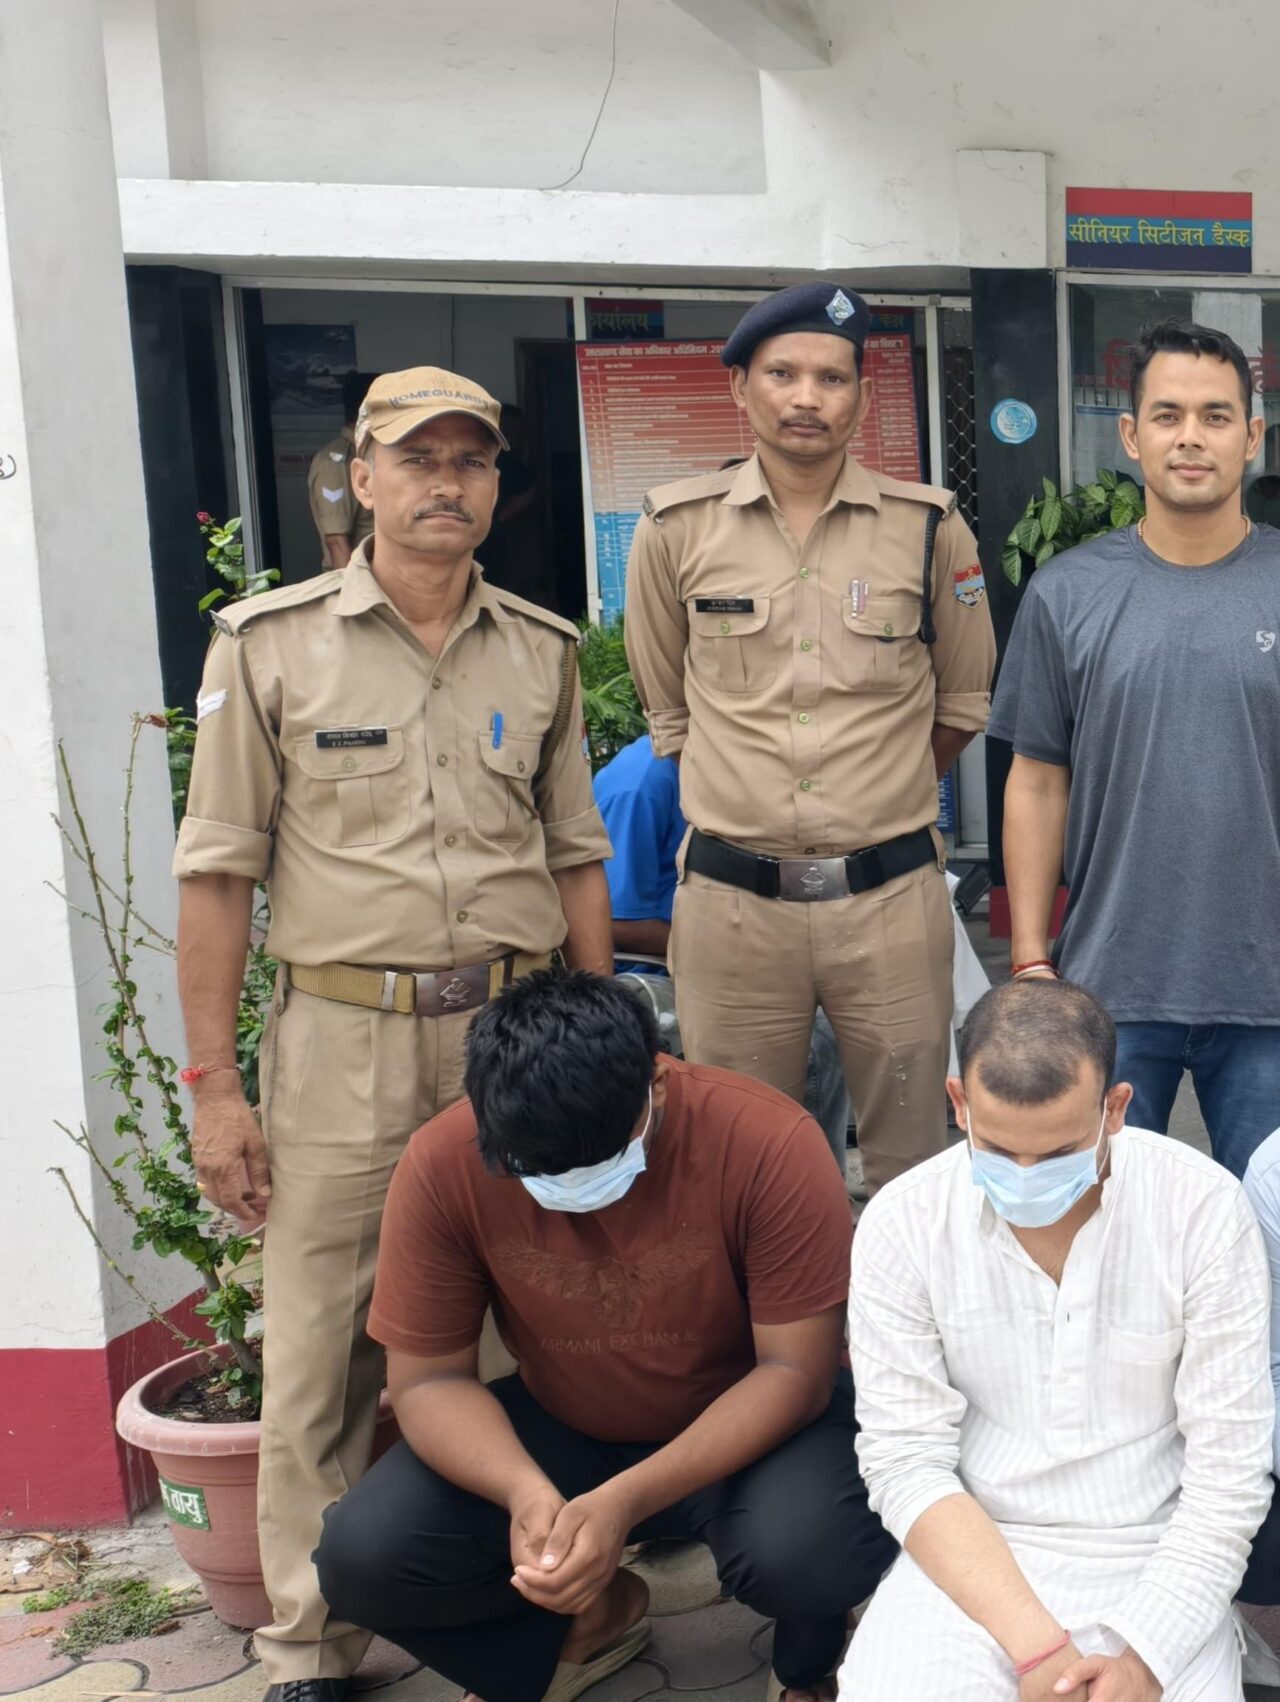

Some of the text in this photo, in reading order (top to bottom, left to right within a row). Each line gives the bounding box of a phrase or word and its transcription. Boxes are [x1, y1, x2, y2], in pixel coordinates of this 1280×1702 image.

[1068, 217, 1251, 248] सीनियर सिटीजन डैस्क
[539, 1330, 698, 1354] ARMANI EXCHANGE
[169, 1488, 203, 1524] वायु
